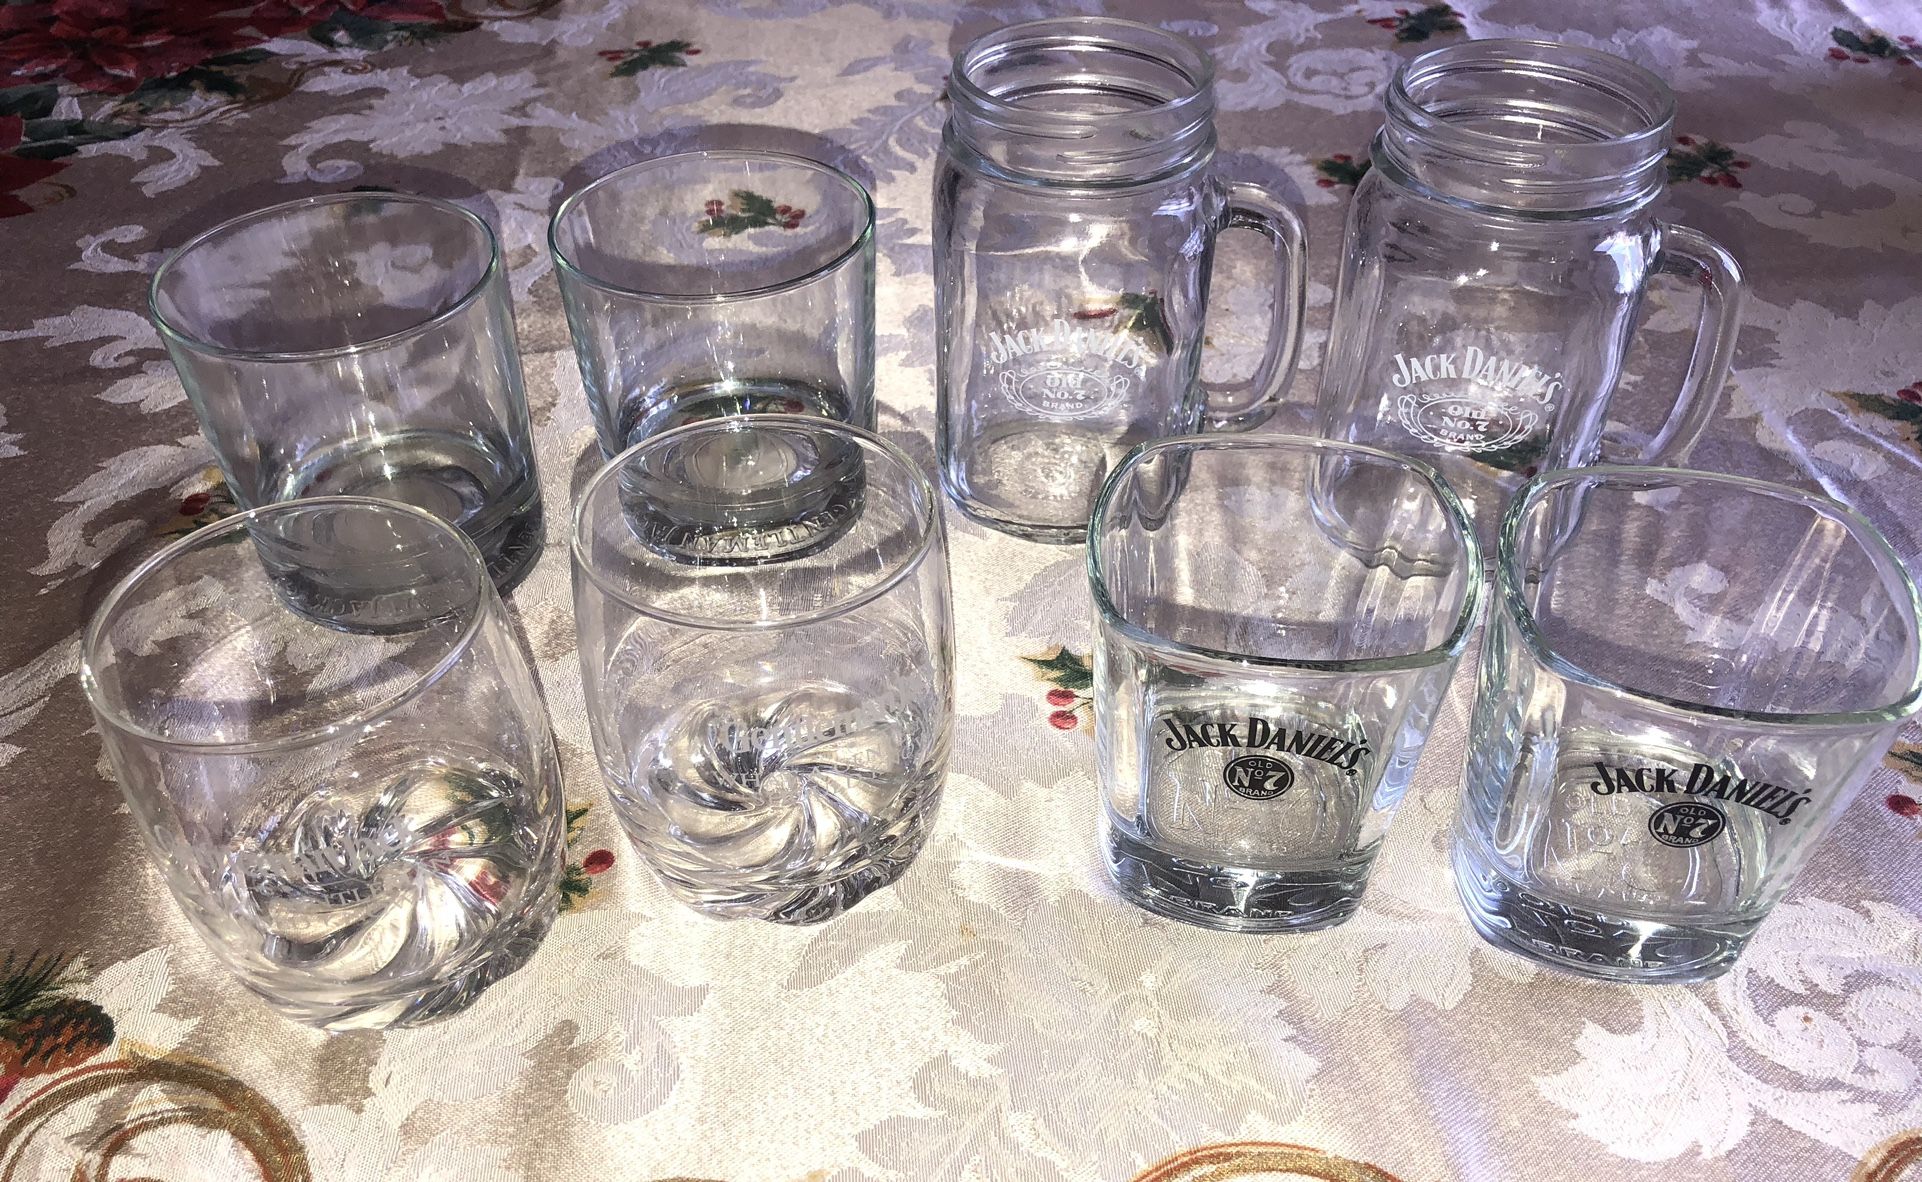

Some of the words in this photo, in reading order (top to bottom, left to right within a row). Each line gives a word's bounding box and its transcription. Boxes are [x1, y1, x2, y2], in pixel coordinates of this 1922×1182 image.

[989, 327, 1045, 364] JACK
[1391, 353, 1457, 388] JACK
[1162, 717, 1239, 751] JACK
[1248, 760, 1273, 769] OLD
[1590, 762, 1677, 796] JACK
[1239, 787, 1274, 796] BRAND
[1679, 807, 1706, 816] OLD
[1661, 834, 1699, 844] BRAND
